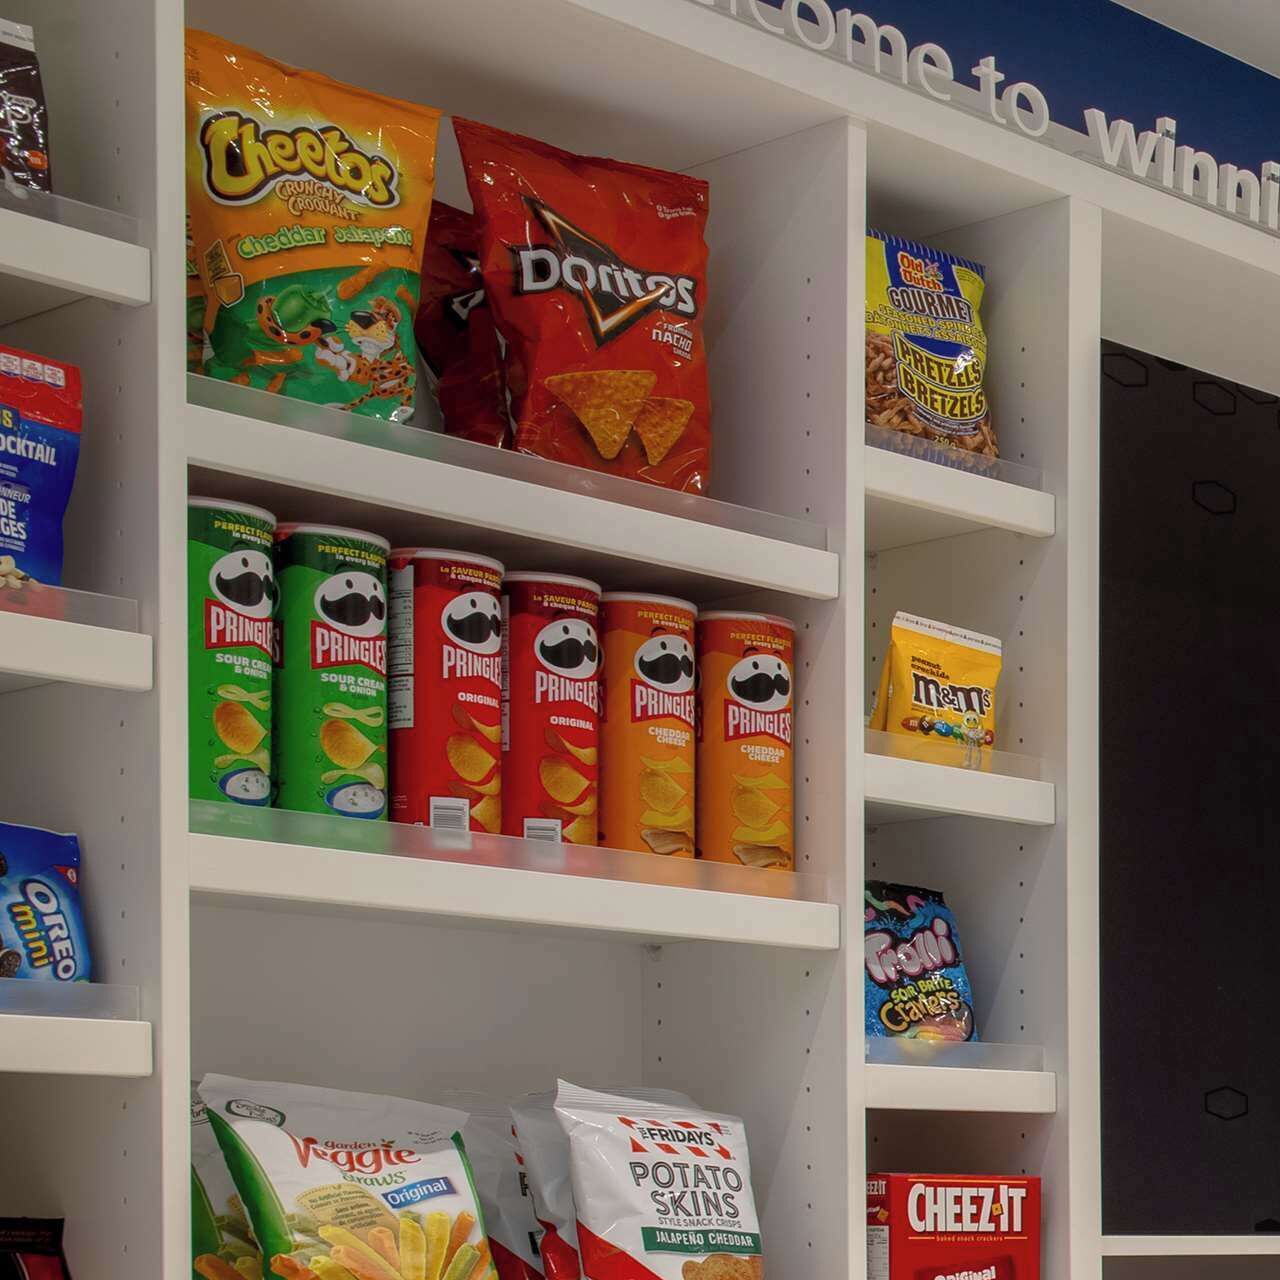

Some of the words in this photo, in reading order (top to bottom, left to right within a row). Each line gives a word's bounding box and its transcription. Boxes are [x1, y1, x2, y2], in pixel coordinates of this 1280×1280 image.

[971, 56, 1049, 137] to
[203, 114, 392, 203] Cheetos
[275, 180, 344, 204] CRUNCHY
[288, 198, 360, 221] CROQUANT
[898, 251, 924, 275] Old
[518, 247, 695, 315] Doritos
[902, 269, 943, 293] Dutch
[889, 287, 974, 324] GOURMET
[899, 339, 983, 390] PRETZELS
[900, 370, 986, 420] BRETZELS
[213, 520, 256, 536] PERFECT
[317, 544, 360, 558] PERFECT
[215, 653, 249, 668] SOUR
[315, 626, 387, 675] PRINGLES
[320, 672, 355, 685] SOUR
[349, 684, 377, 697] ONION
[635, 685, 695, 728] PRINGLES
[550, 715, 594, 732] ORIGINAL
[648, 726, 690, 741] CHEDDAR
[728, 704, 792, 744] PRINGLES
[656, 734, 686, 748] CHEESE
[740, 744, 785, 758] CHEDDAR
[12, 904, 54, 967] mini
[25, 881, 77, 980] OREO
[864, 918, 957, 982] Trolli
[649, 1128, 714, 1147] FRIDAYS
[291, 1134, 422, 1175] Veggie
[629, 1161, 743, 1193] POTATO
[389, 1179, 448, 1205] Original
[650, 1189, 740, 1218] SKINS
[658, 1217, 683, 1227] STYLE
[684, 1218, 714, 1228] SNACK
[716, 1219, 742, 1229] CRISPS
[656, 1230, 704, 1246] JALAPEÑO
[708, 1231, 754, 1248] CHEDDAR
